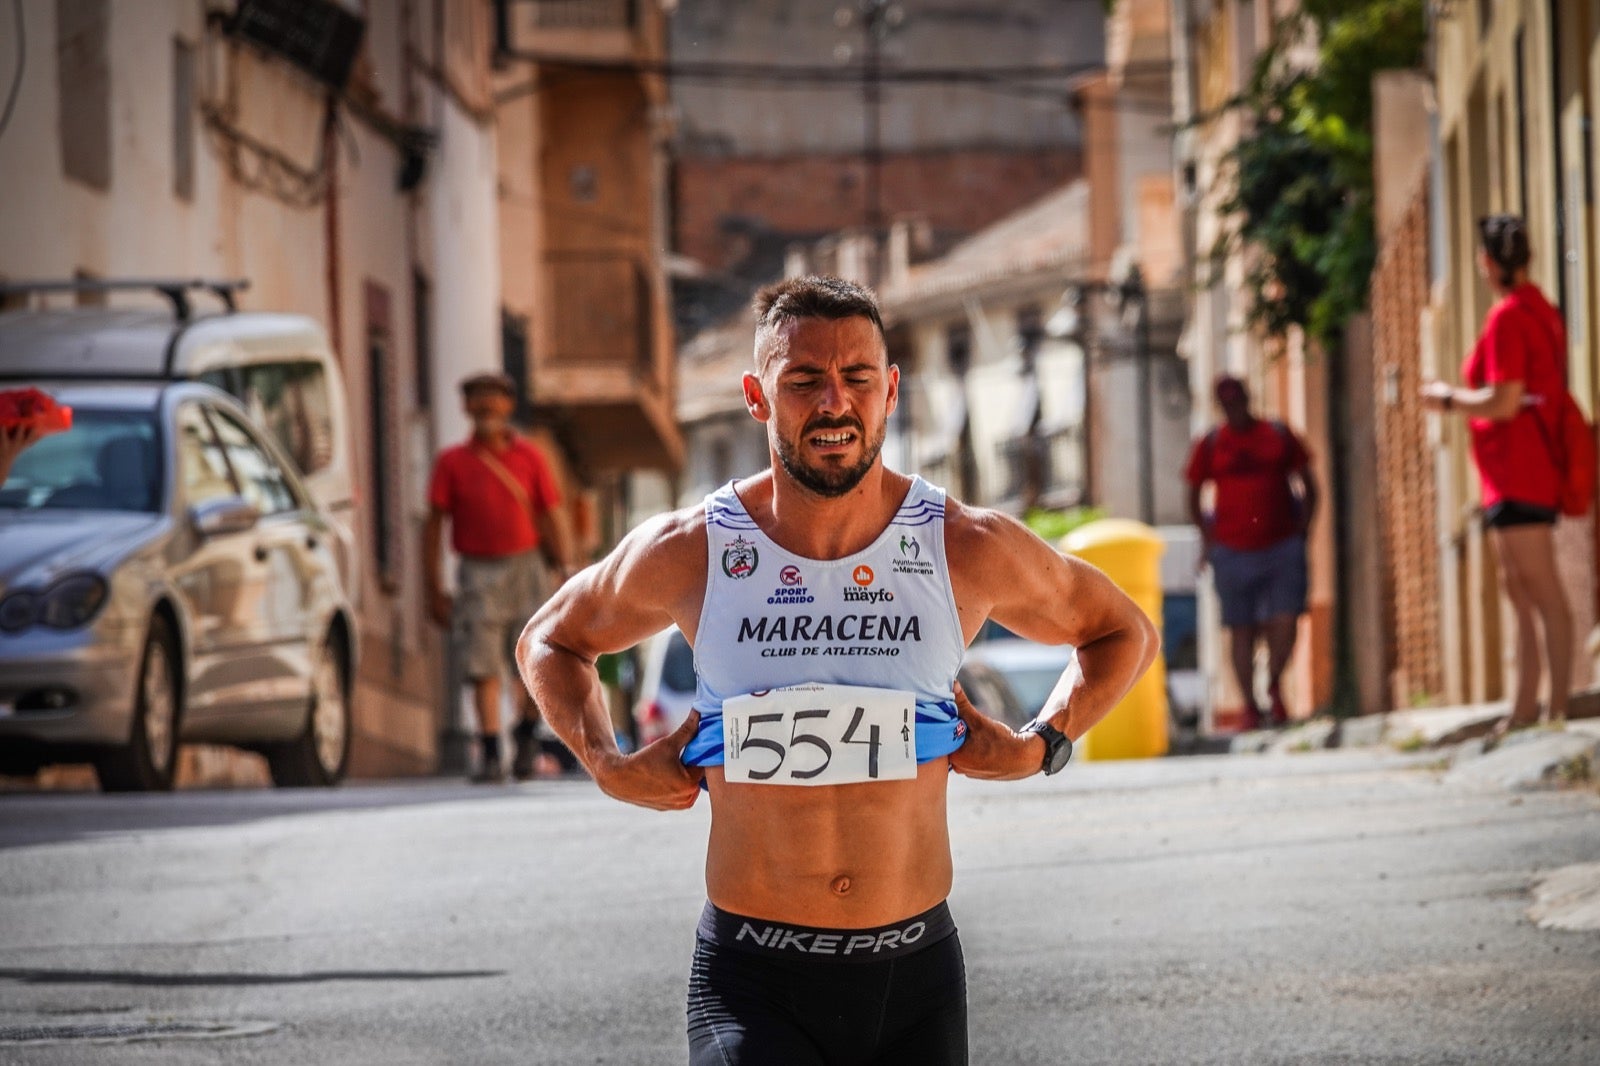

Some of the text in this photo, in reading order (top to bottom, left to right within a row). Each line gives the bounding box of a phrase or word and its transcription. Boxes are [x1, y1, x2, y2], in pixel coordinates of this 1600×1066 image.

[899, 566, 934, 575] Maracena
[775, 587, 808, 596] SPORT
[843, 588, 894, 605] mayfo
[767, 596, 815, 605] GARRIDO
[737, 614, 922, 643] MARACENA
[761, 646, 900, 658] CLUB DE ATLETISMO
[740, 706, 883, 780] 554
[735, 921, 926, 955] NIKE PRO
